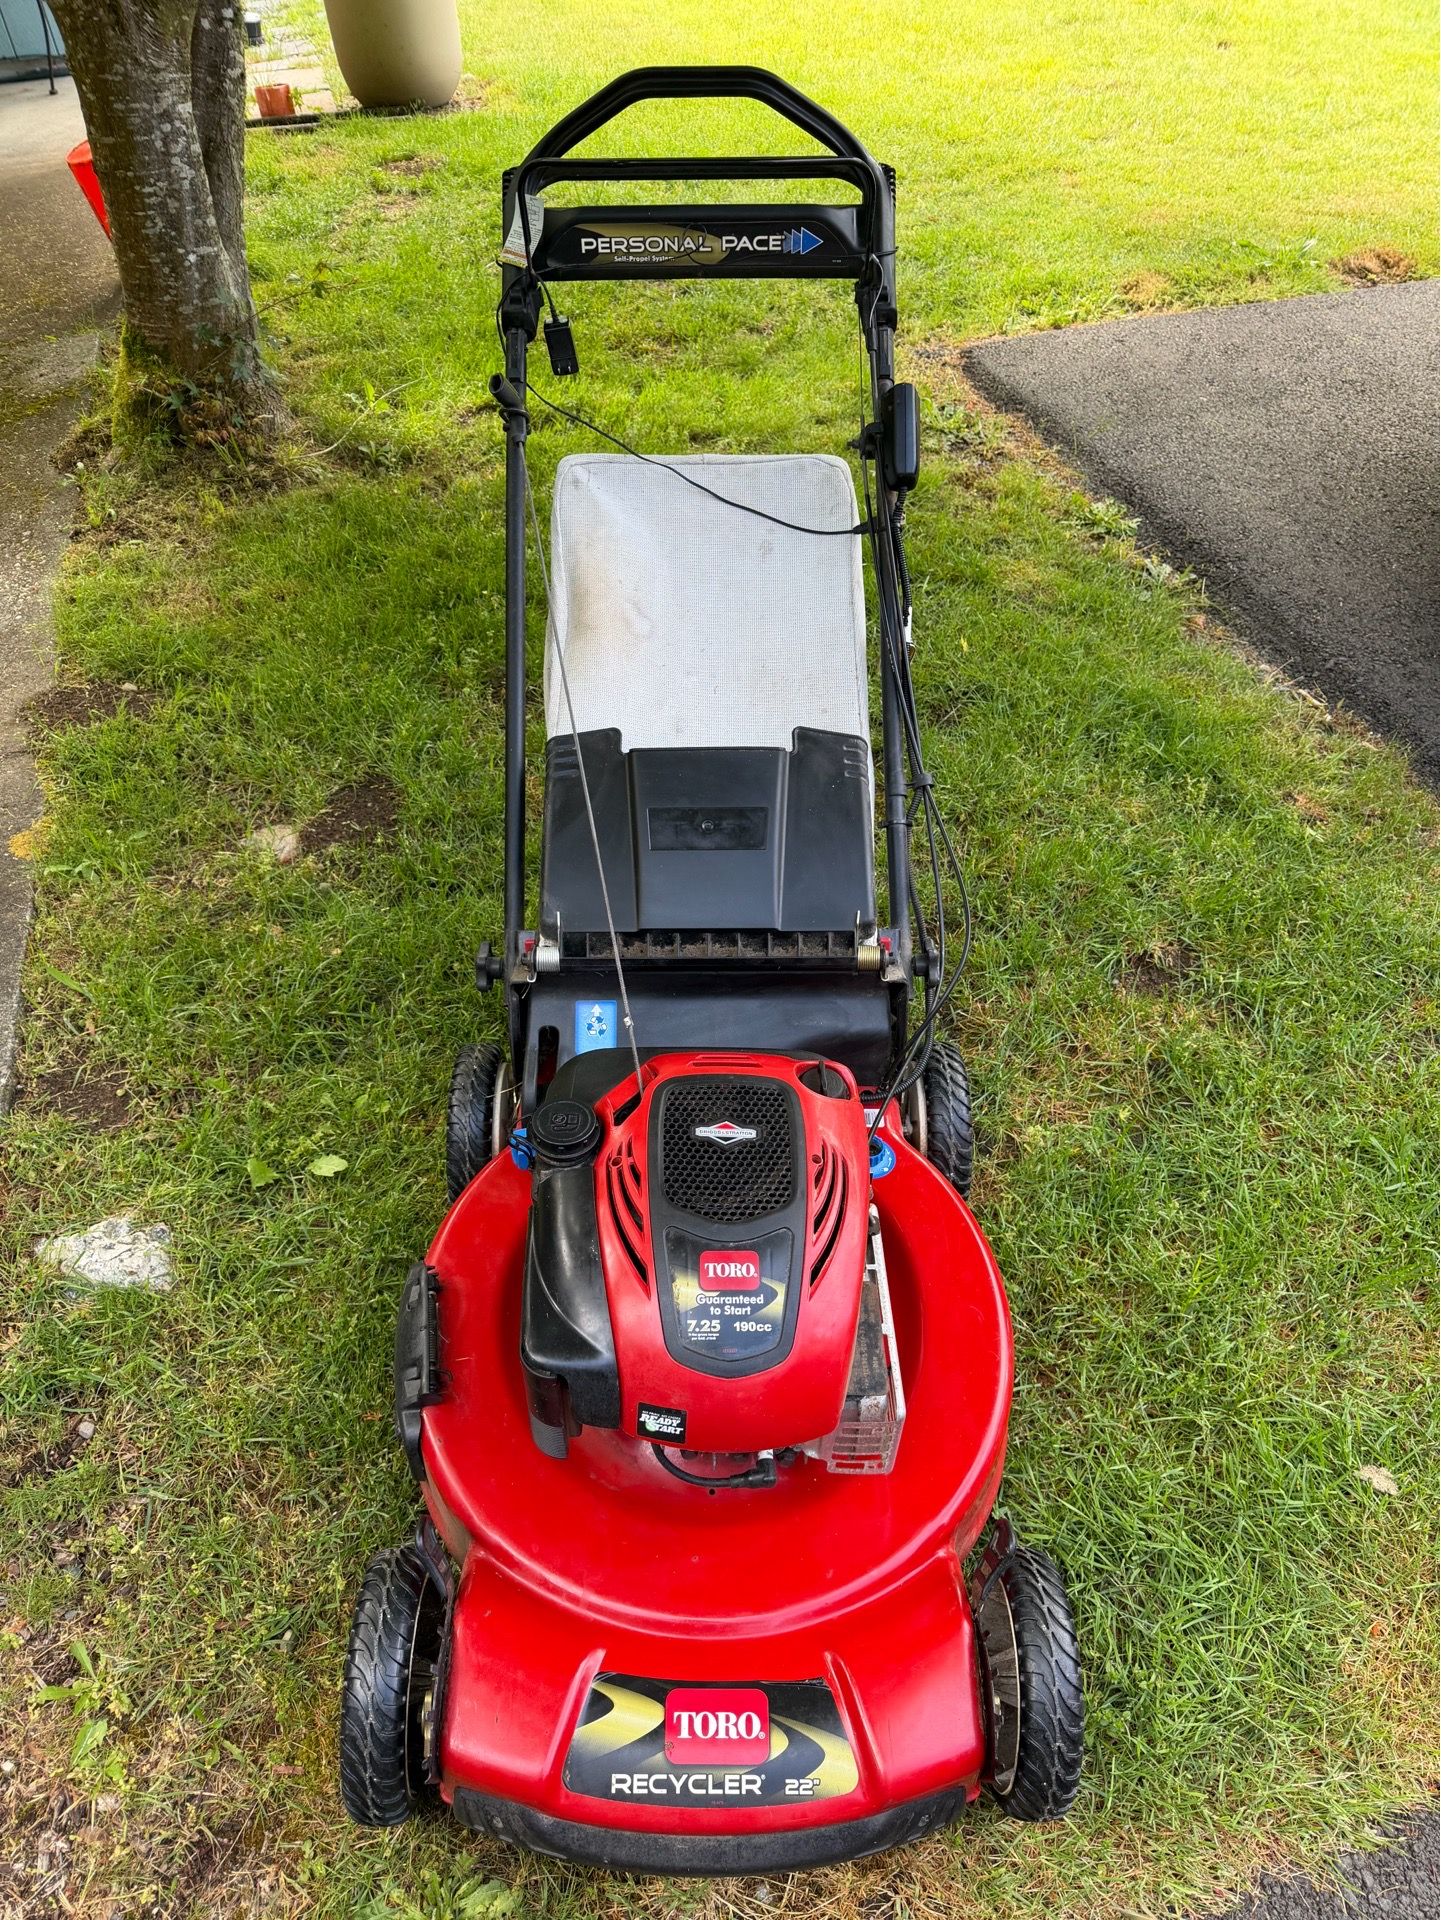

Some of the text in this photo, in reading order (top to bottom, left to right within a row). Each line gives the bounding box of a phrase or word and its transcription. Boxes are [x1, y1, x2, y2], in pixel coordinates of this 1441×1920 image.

[581, 235, 782, 254] PERSONAL PACE
[614, 255, 650, 263] Self-Propel
[704, 1262, 754, 1278] TORO
[697, 1294, 764, 1305] Guaranteed
[710, 1305, 751, 1315] to Start
[687, 1319, 772, 1332] 7.25 190cc
[639, 1413, 681, 1427] READY
[673, 1711, 761, 1739] TORO
[611, 1773, 821, 1795] RECYCLER 22"
